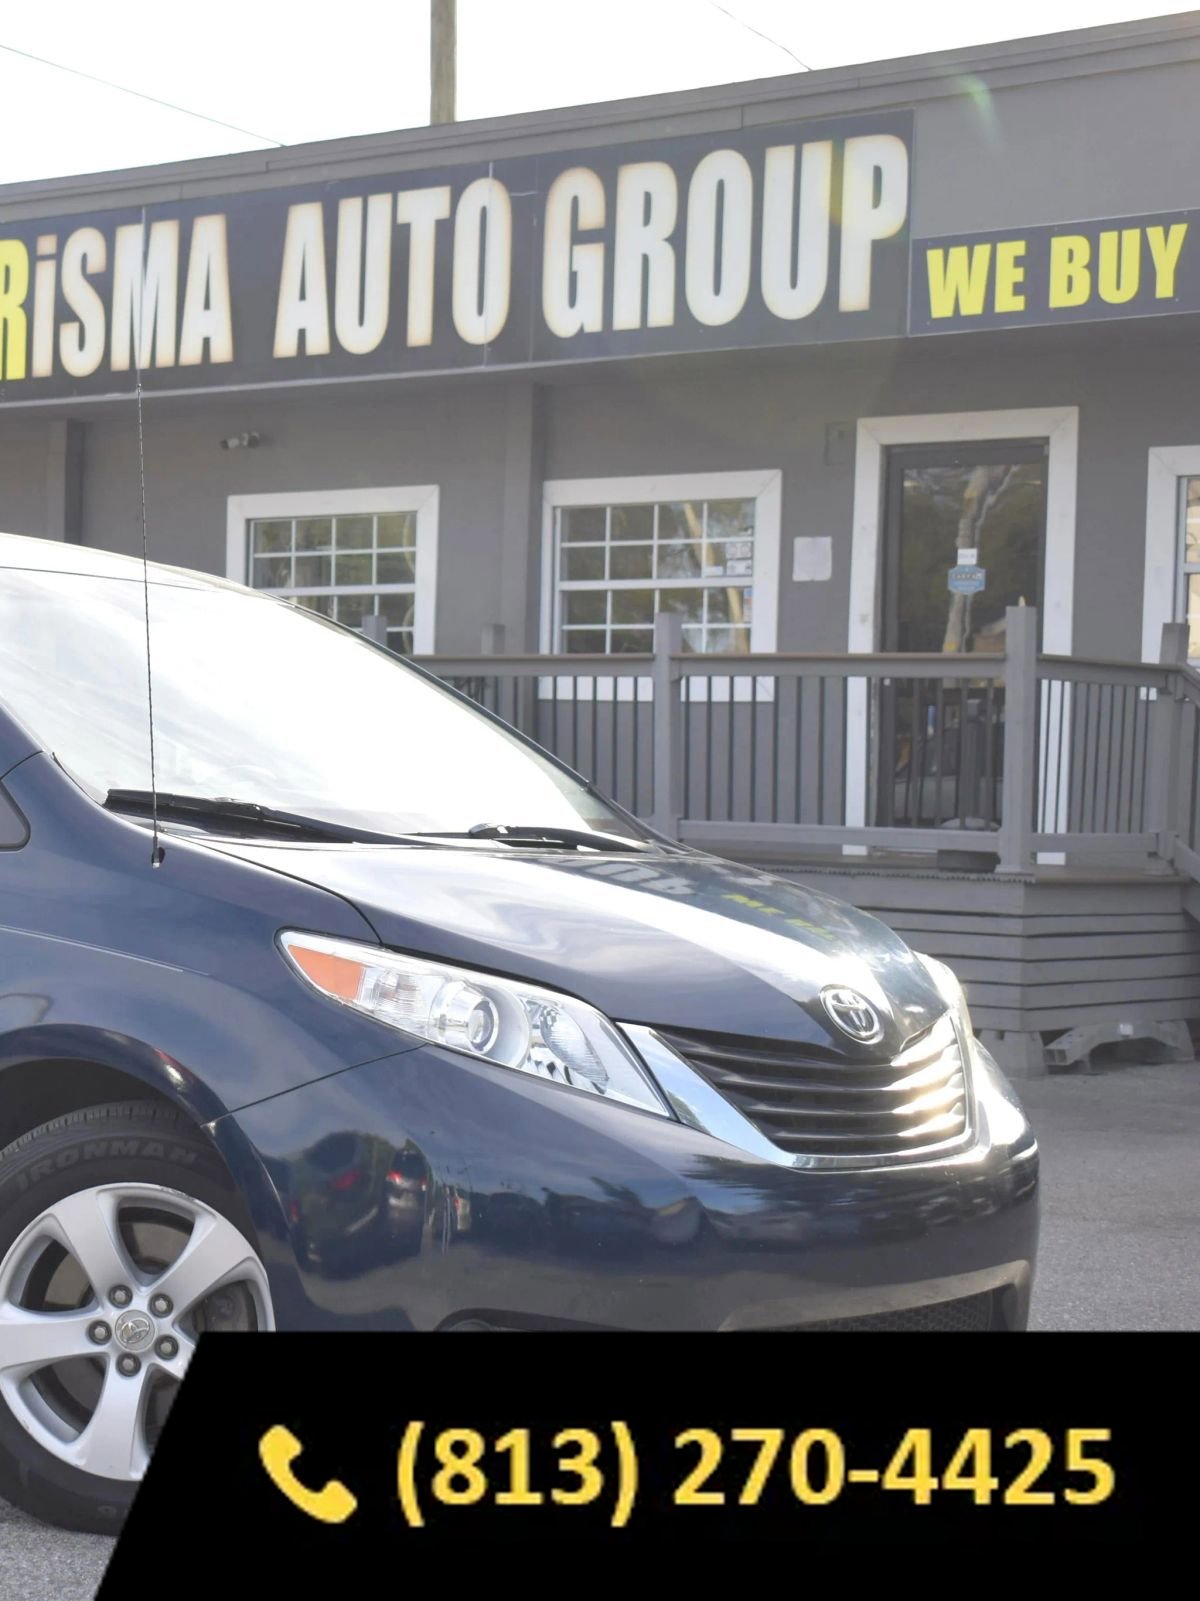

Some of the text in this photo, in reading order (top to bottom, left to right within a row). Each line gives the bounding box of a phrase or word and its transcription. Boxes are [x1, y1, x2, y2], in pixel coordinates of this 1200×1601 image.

[273, 177, 512, 358] AUTO
[542, 133, 909, 338] GROUP
[926, 223, 1189, 318] WE BUY
[15, 1138, 197, 1191] IRONMAN
